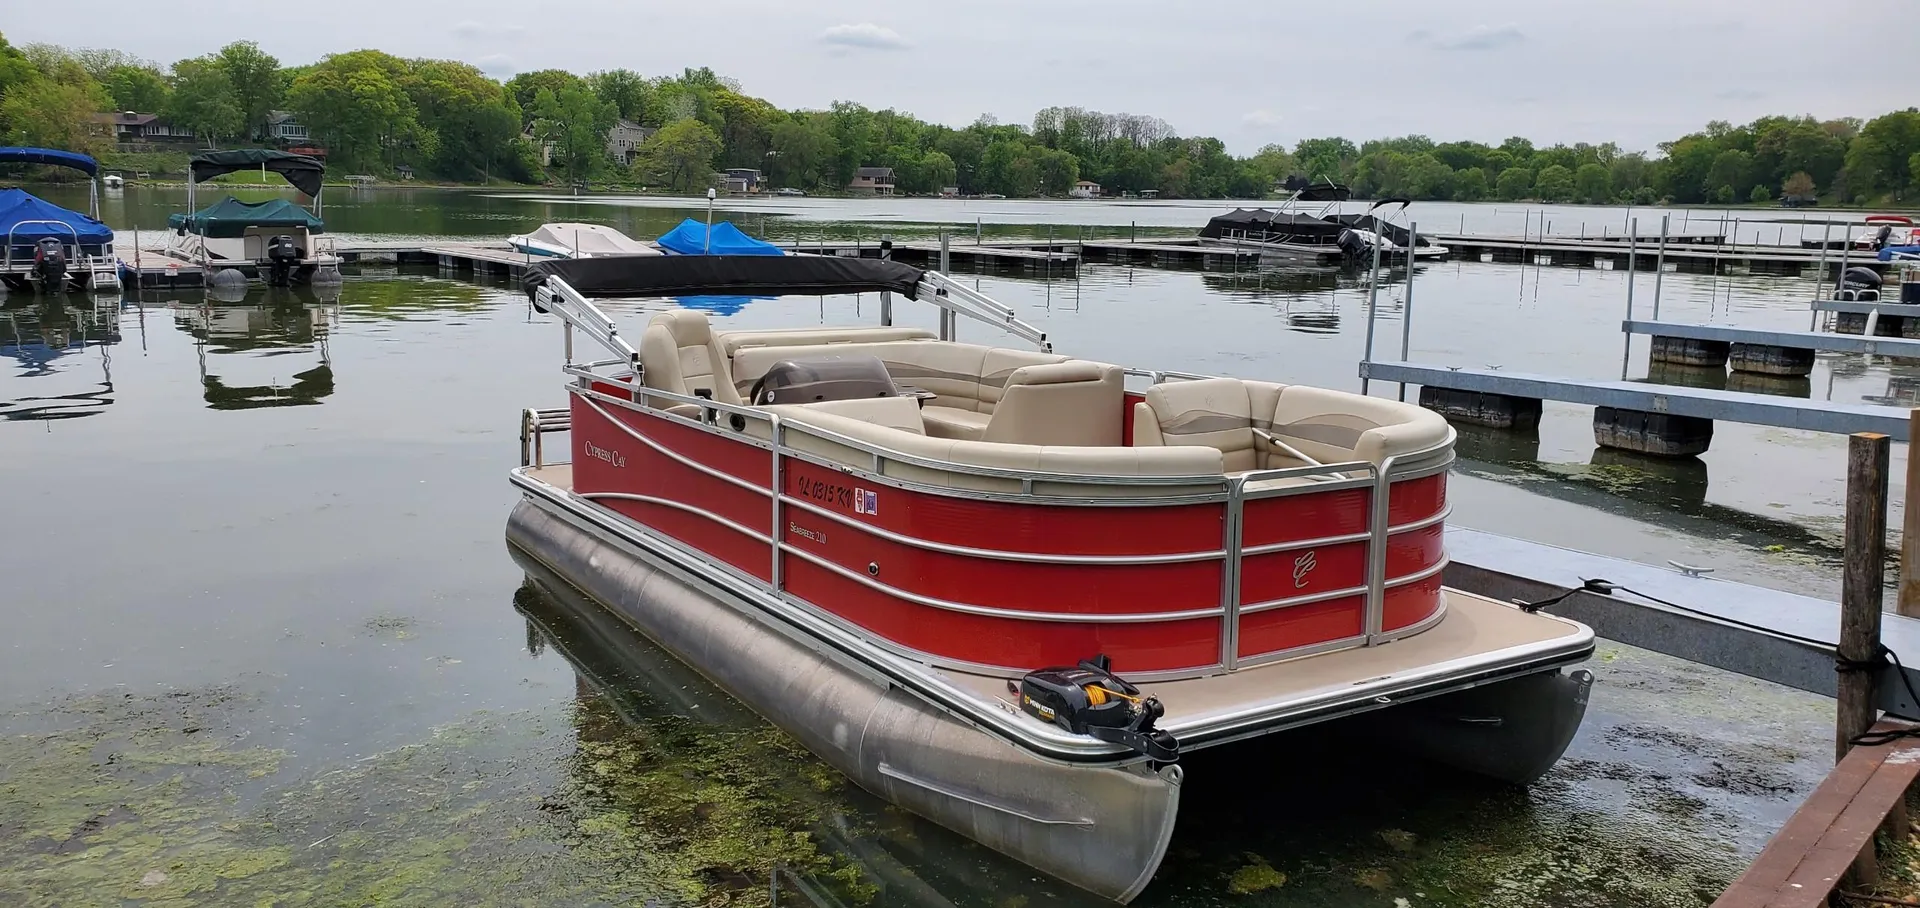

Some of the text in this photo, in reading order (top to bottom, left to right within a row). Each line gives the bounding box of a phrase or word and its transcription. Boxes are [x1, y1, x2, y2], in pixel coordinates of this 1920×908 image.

[585, 440, 626, 468] CYPRESS CAY
[813, 480, 835, 503] 0315
[790, 521, 828, 545] SEABREEZE 210
[1041, 704, 1055, 715] KOTA
